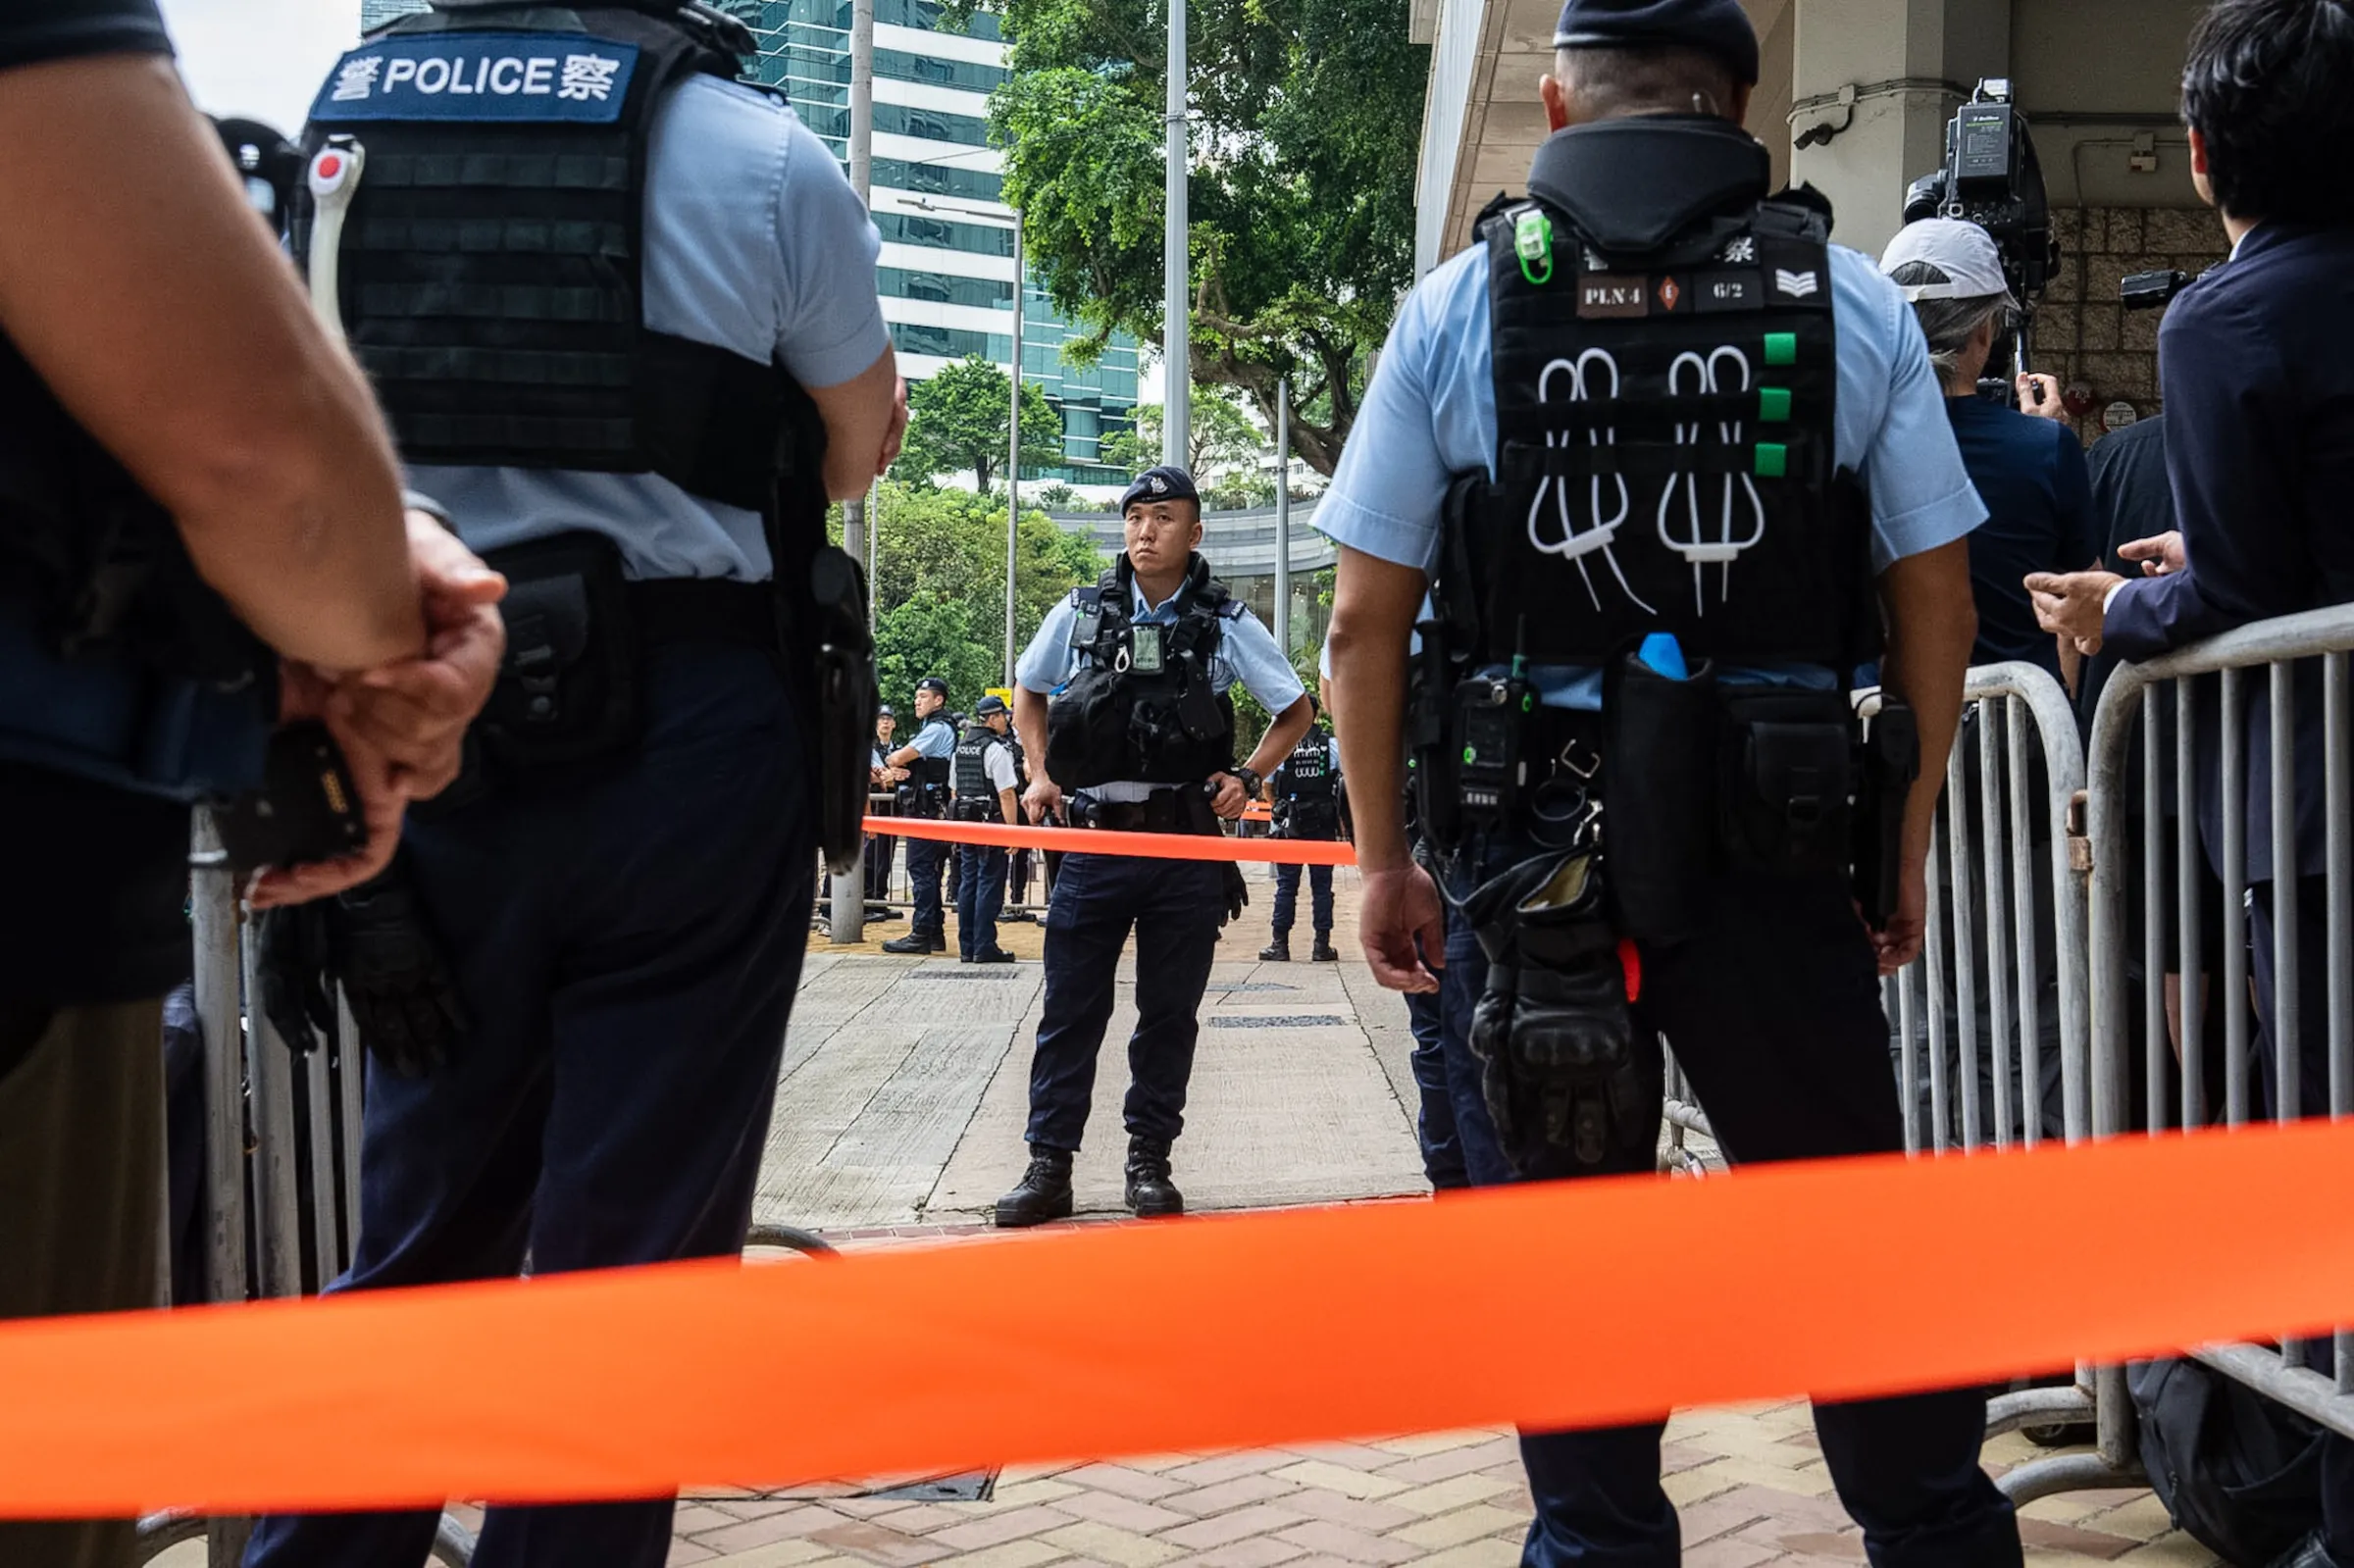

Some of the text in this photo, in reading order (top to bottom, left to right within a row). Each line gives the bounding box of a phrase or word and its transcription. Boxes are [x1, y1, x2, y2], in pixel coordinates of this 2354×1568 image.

[381, 57, 557, 95] POLICE
[556, 53, 621, 101] 察
[1584, 287, 1641, 305] PLN 4
[955, 745, 982, 756] POLICE
